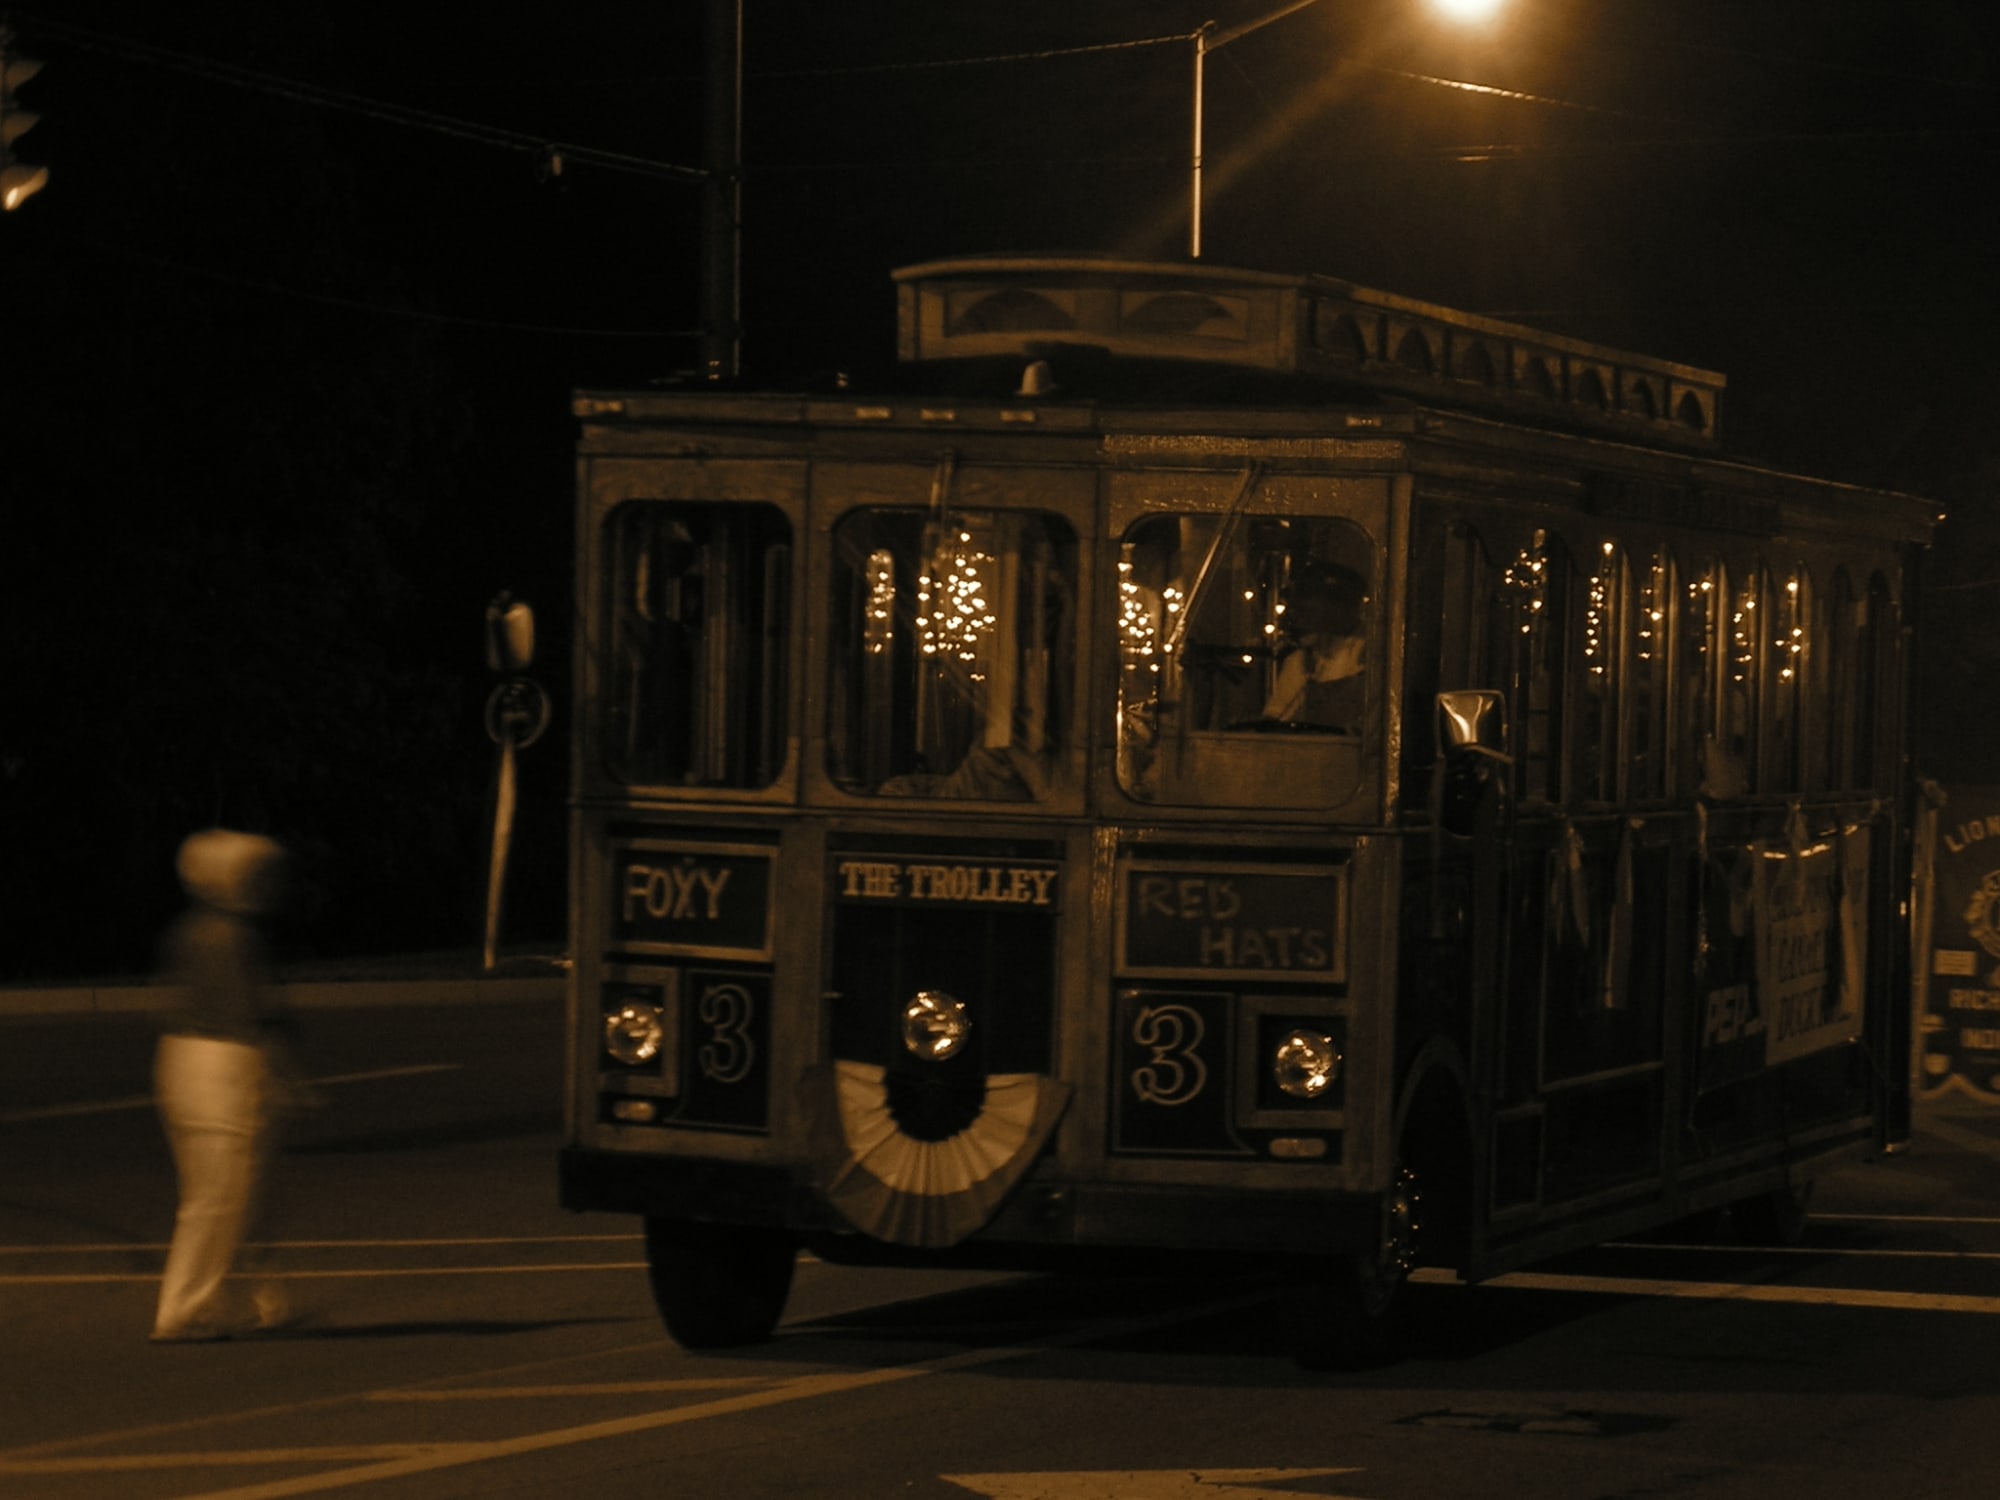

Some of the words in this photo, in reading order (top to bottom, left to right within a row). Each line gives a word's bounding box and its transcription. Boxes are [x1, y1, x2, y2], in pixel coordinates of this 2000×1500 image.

[622, 862, 731, 922] FOXY
[839, 861, 902, 898] THE
[905, 864, 1057, 905] TROLLEY
[1137, 875, 1241, 920] RED
[1200, 926, 1328, 969] HATS
[697, 980, 756, 1086] 3
[1130, 1003, 1209, 1110] 3
